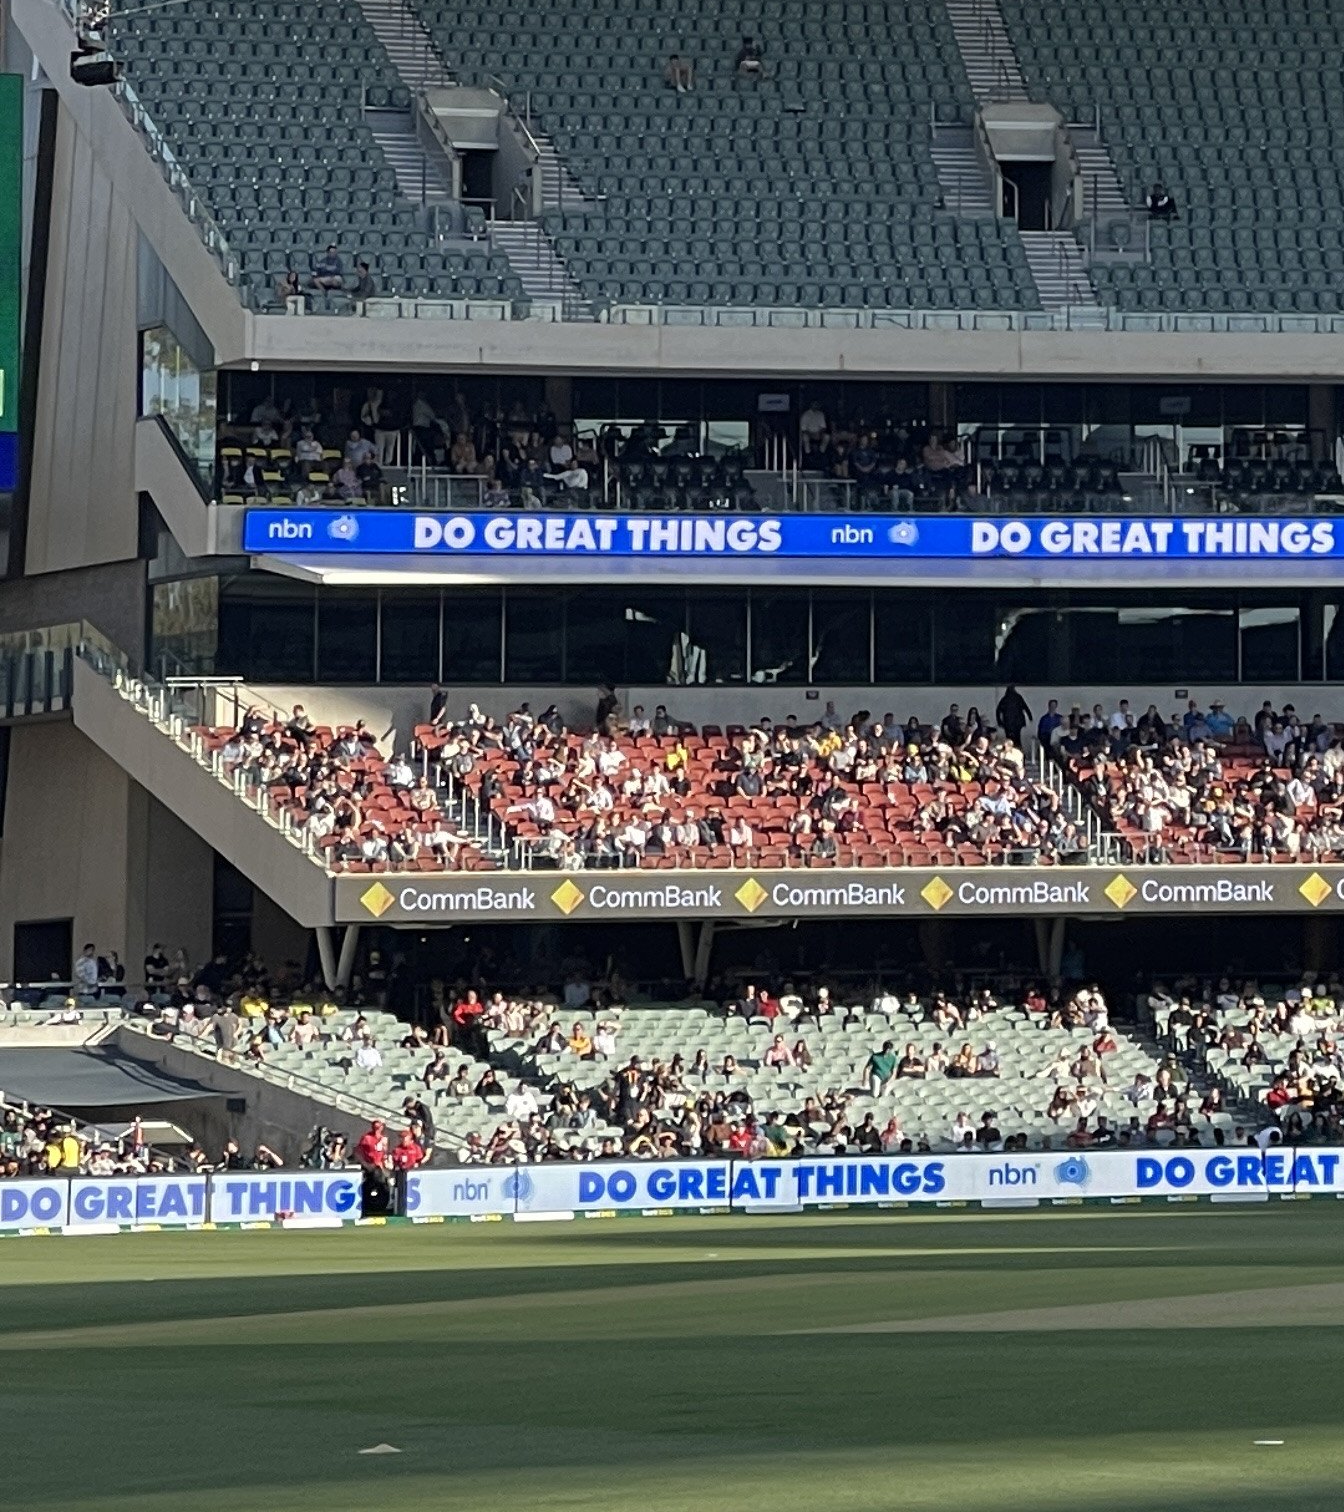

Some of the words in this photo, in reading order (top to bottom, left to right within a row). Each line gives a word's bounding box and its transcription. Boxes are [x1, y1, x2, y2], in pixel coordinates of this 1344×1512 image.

[268, 518, 312, 539] nbn
[414, 516, 476, 549] DO
[484, 517, 618, 550] GREAT
[626, 516, 782, 552] THINGS
[831, 524, 874, 545] nbn
[971, 521, 1032, 553] DO
[1040, 521, 1174, 554] GREAT
[1182, 521, 1335, 554] THINGS
[400, 887, 535, 911] CommBank
[589, 885, 722, 908] CommBank
[772, 883, 905, 906] CommBank
[958, 881, 1090, 904] CommBank
[1141, 879, 1274, 902] CommBank
[578, 1171, 637, 1203] DO
[646, 1167, 782, 1200] GREAT
[792, 1163, 946, 1199] THINGS
[989, 1162, 1037, 1186] nbn
[1136, 1156, 1196, 1188] DO
[1204, 1154, 1340, 1187] GREAT
[1, 1187, 62, 1221] DO
[74, 1181, 216, 1219] GREAT
[453, 1177, 488, 1201] nbn
